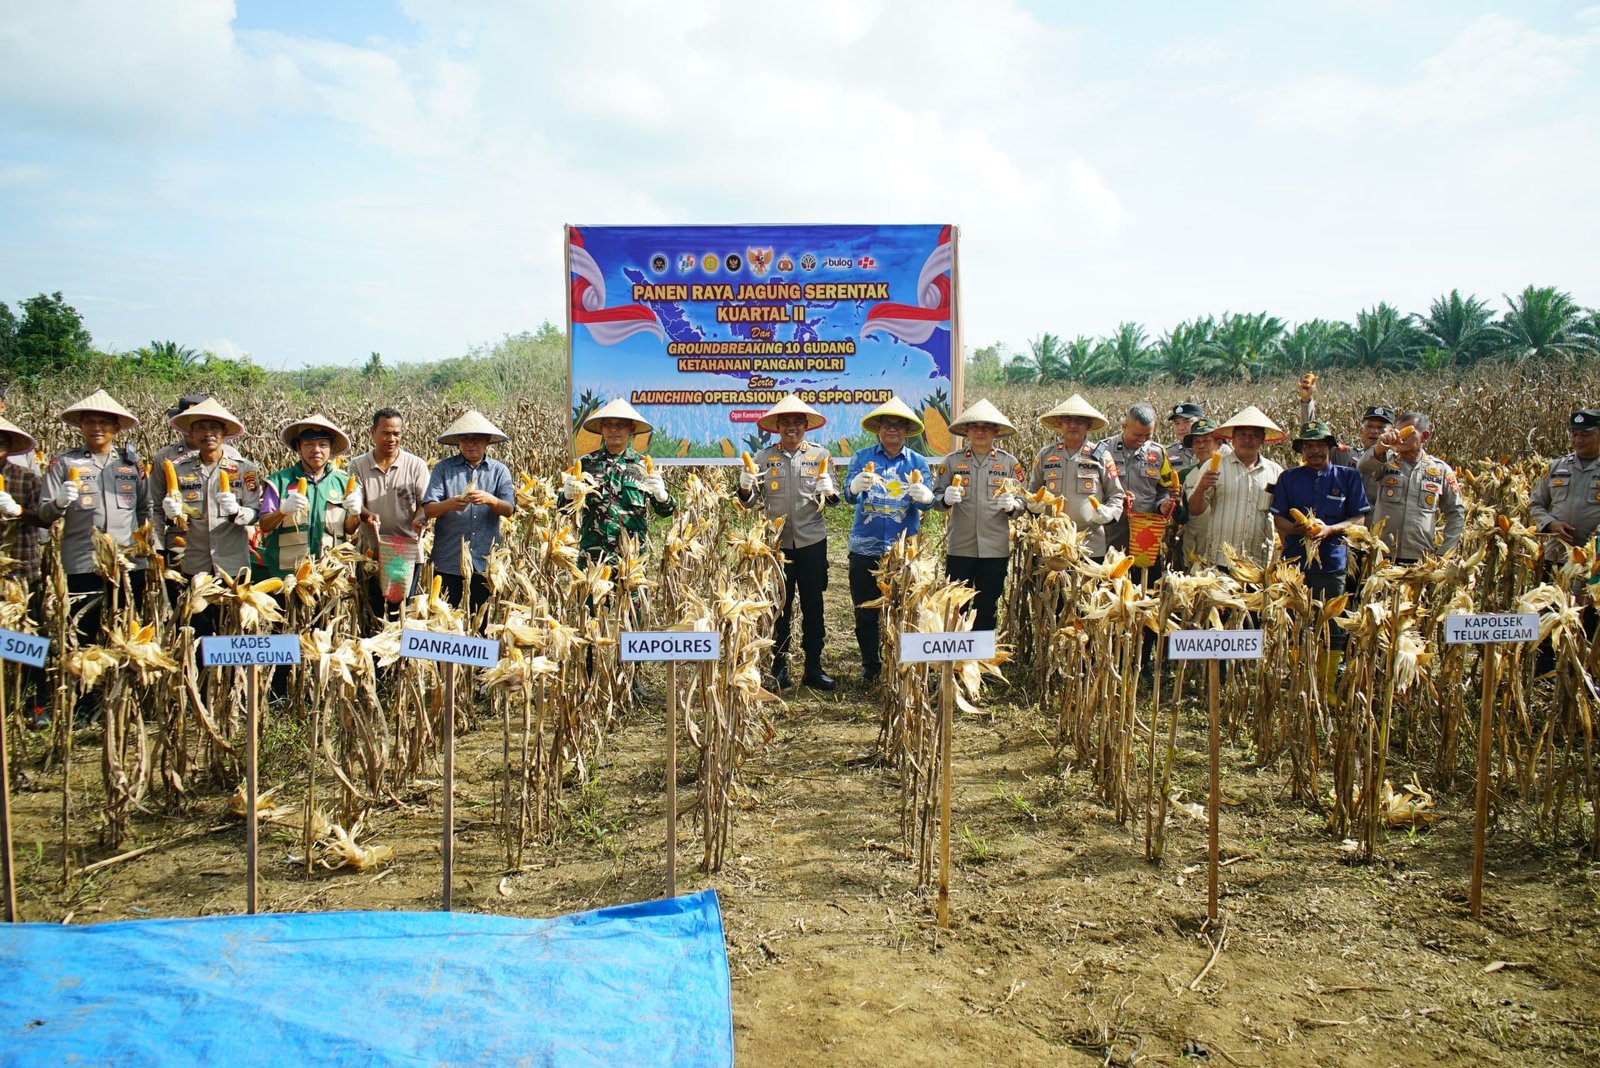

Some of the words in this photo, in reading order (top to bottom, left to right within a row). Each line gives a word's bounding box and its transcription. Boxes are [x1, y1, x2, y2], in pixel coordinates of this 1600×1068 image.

[828, 257, 852, 268] bulog
[633, 284, 688, 300] PANEN
[691, 284, 734, 300] RAYA
[737, 284, 801, 300] JAGUNG
[804, 283, 889, 299] SERENTAK
[717, 306, 790, 322] KUARTAL
[793, 305, 806, 321] II
[751, 326, 771, 338] Dan
[667, 342, 783, 355] GROUNDBREAKING
[785, 342, 801, 354] 10
[803, 341, 855, 354] GUDANG
[678, 359, 751, 371] KETAHANAN
[753, 358, 804, 371] PANGAN
[806, 358, 845, 370] POLRI
[749, 376, 775, 388] Serta
[631, 391, 702, 404] LAUNCHING
[818, 391, 852, 403] SPPG
[854, 390, 893, 403] POLRI
[1465, 616, 1523, 628] KAPOLSEK
[1454, 630, 1489, 640] TELUK
[1492, 628, 1532, 640] GELAM
[4, 638, 44, 659] SDM
[231, 637, 271, 649] KADES
[408, 636, 489, 660] DANRAMIL
[628, 639, 712, 654] KAPOLRES
[922, 639, 975, 654] CAMAT
[1174, 638, 1258, 652] WAKAPOLRES
[210, 652, 253, 664] MULYA
[256, 651, 294, 663] GUNA
